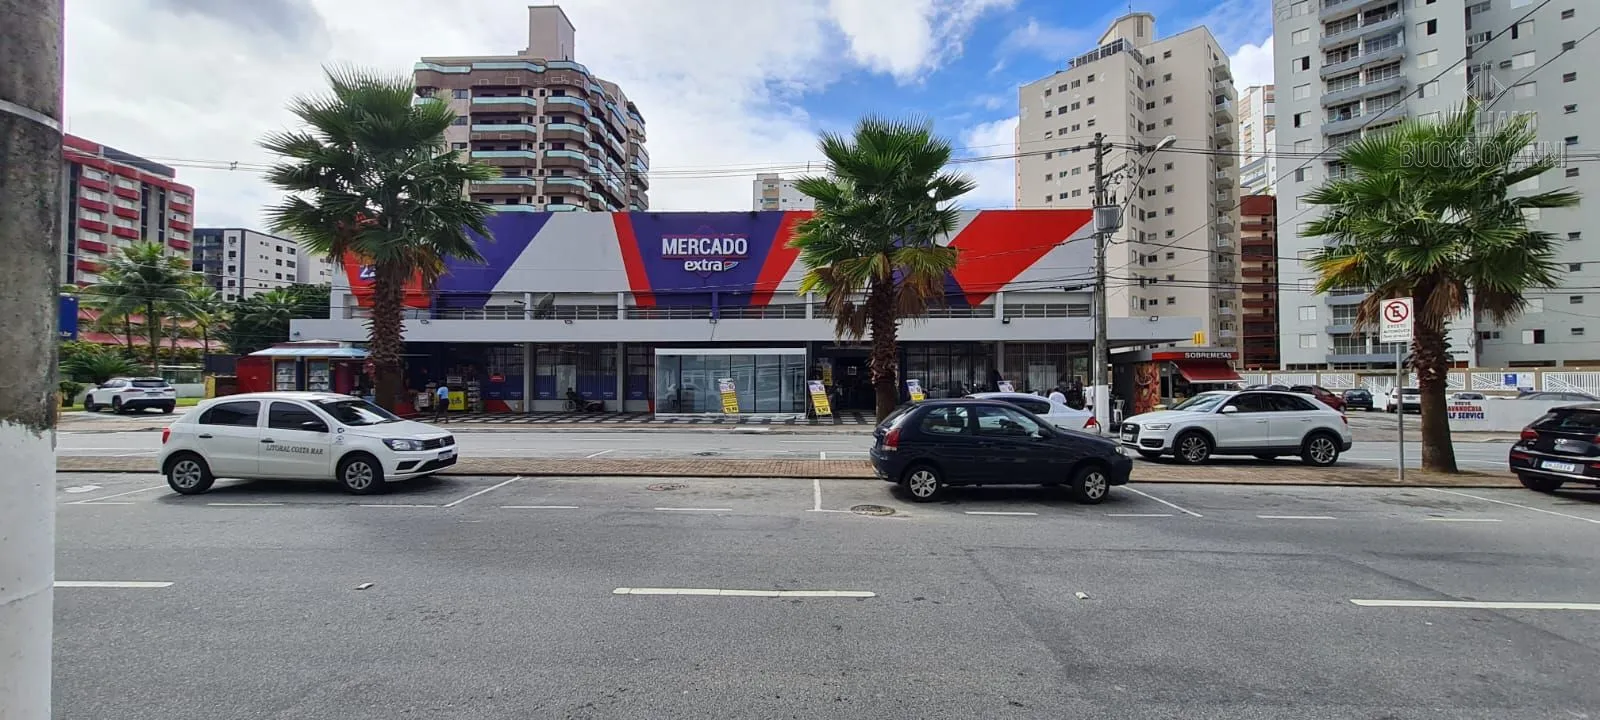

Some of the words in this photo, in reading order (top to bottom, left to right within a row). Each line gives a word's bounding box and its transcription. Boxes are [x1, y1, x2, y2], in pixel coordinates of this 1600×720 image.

[662, 238, 748, 255] MERCADO
[684, 258, 723, 271] extra
[265, 443, 291, 453] LITORAL
